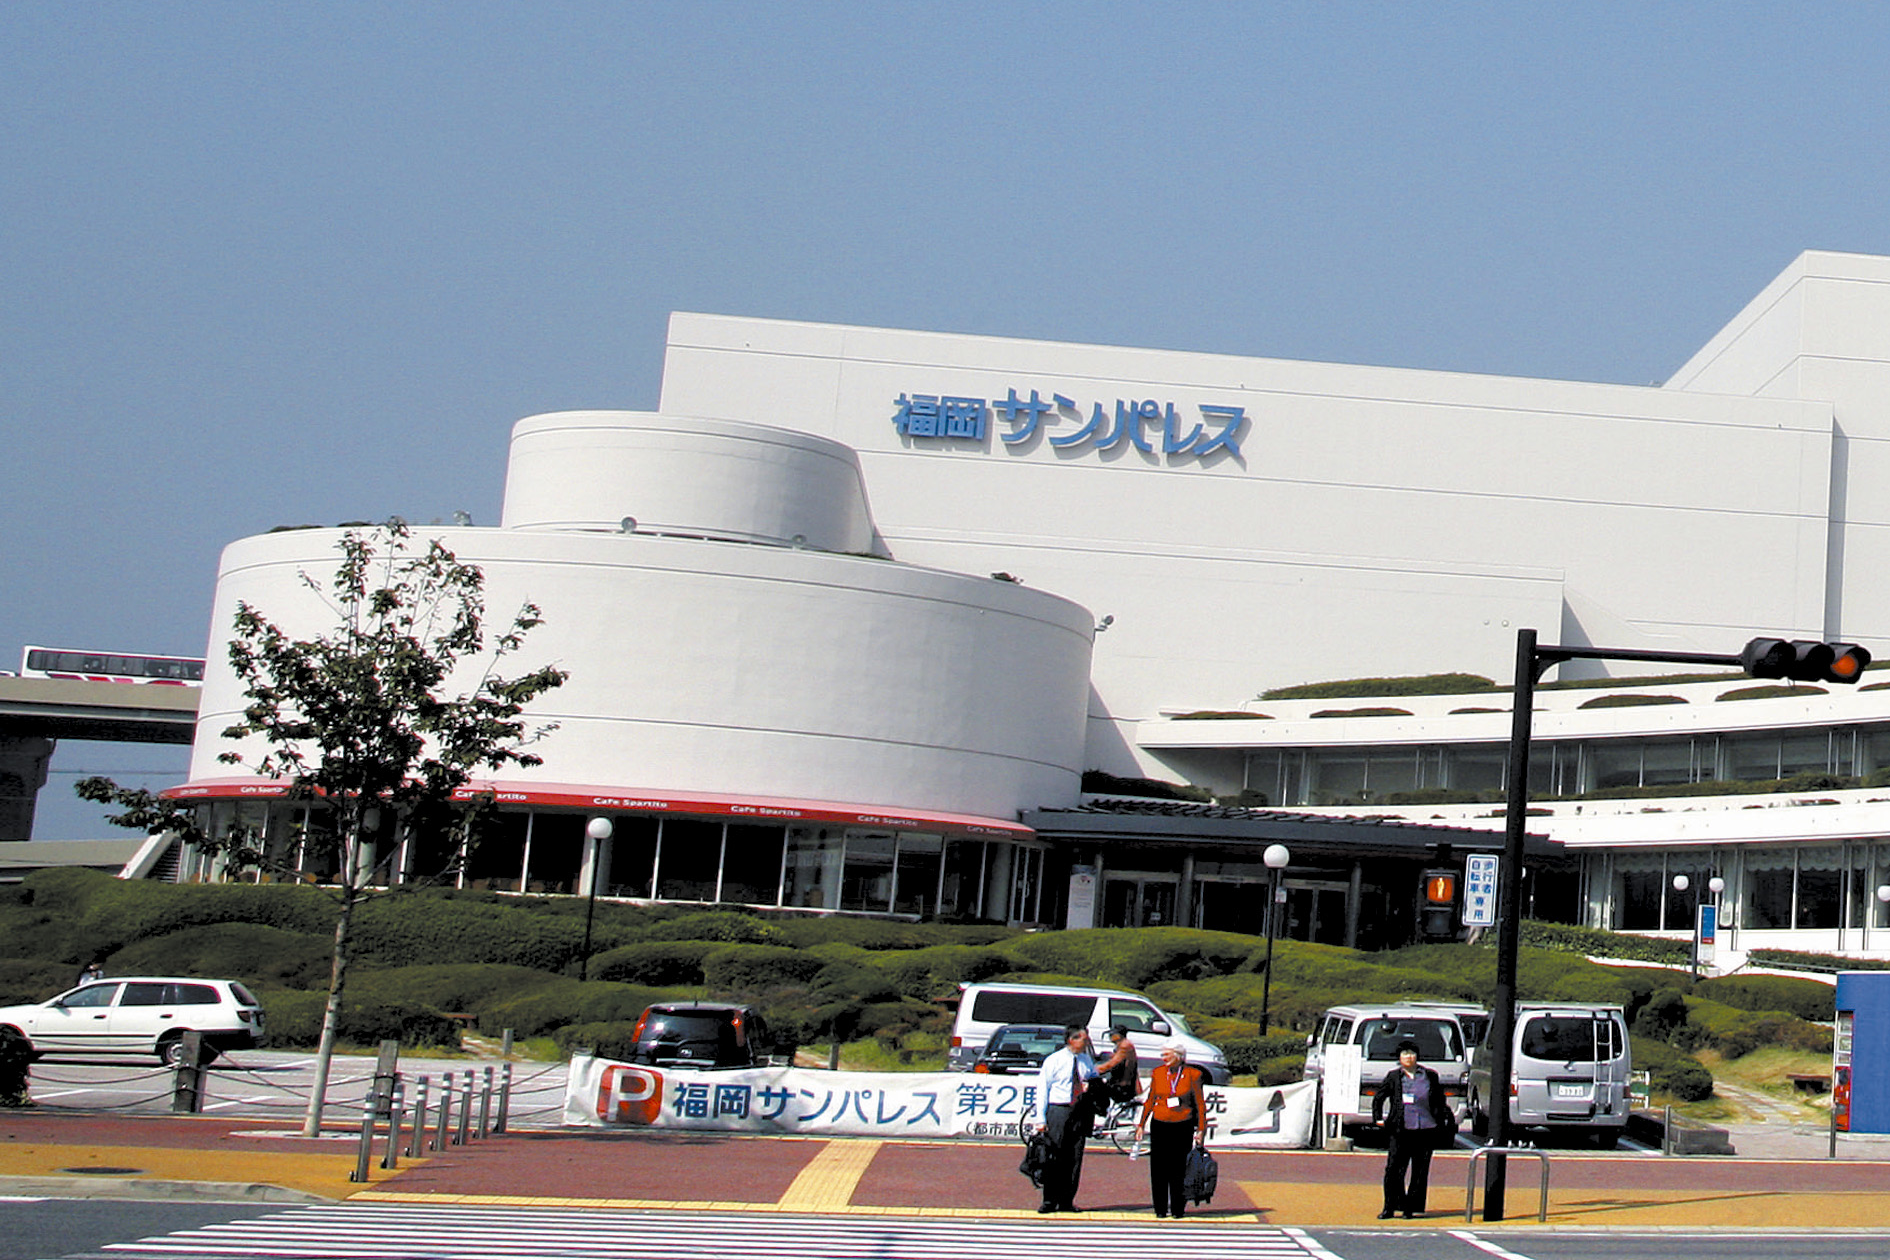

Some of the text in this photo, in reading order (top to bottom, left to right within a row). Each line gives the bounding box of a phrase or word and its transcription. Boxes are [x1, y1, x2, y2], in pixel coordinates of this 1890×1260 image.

[891, 387, 1245, 456] 福岡サンパレス
[593, 797, 668, 808] Cafe Spartito
[731, 805, 757, 814] Cafe
[606, 1068, 657, 1123] P
[672, 1082, 941, 1126] 福岡サンパレス
